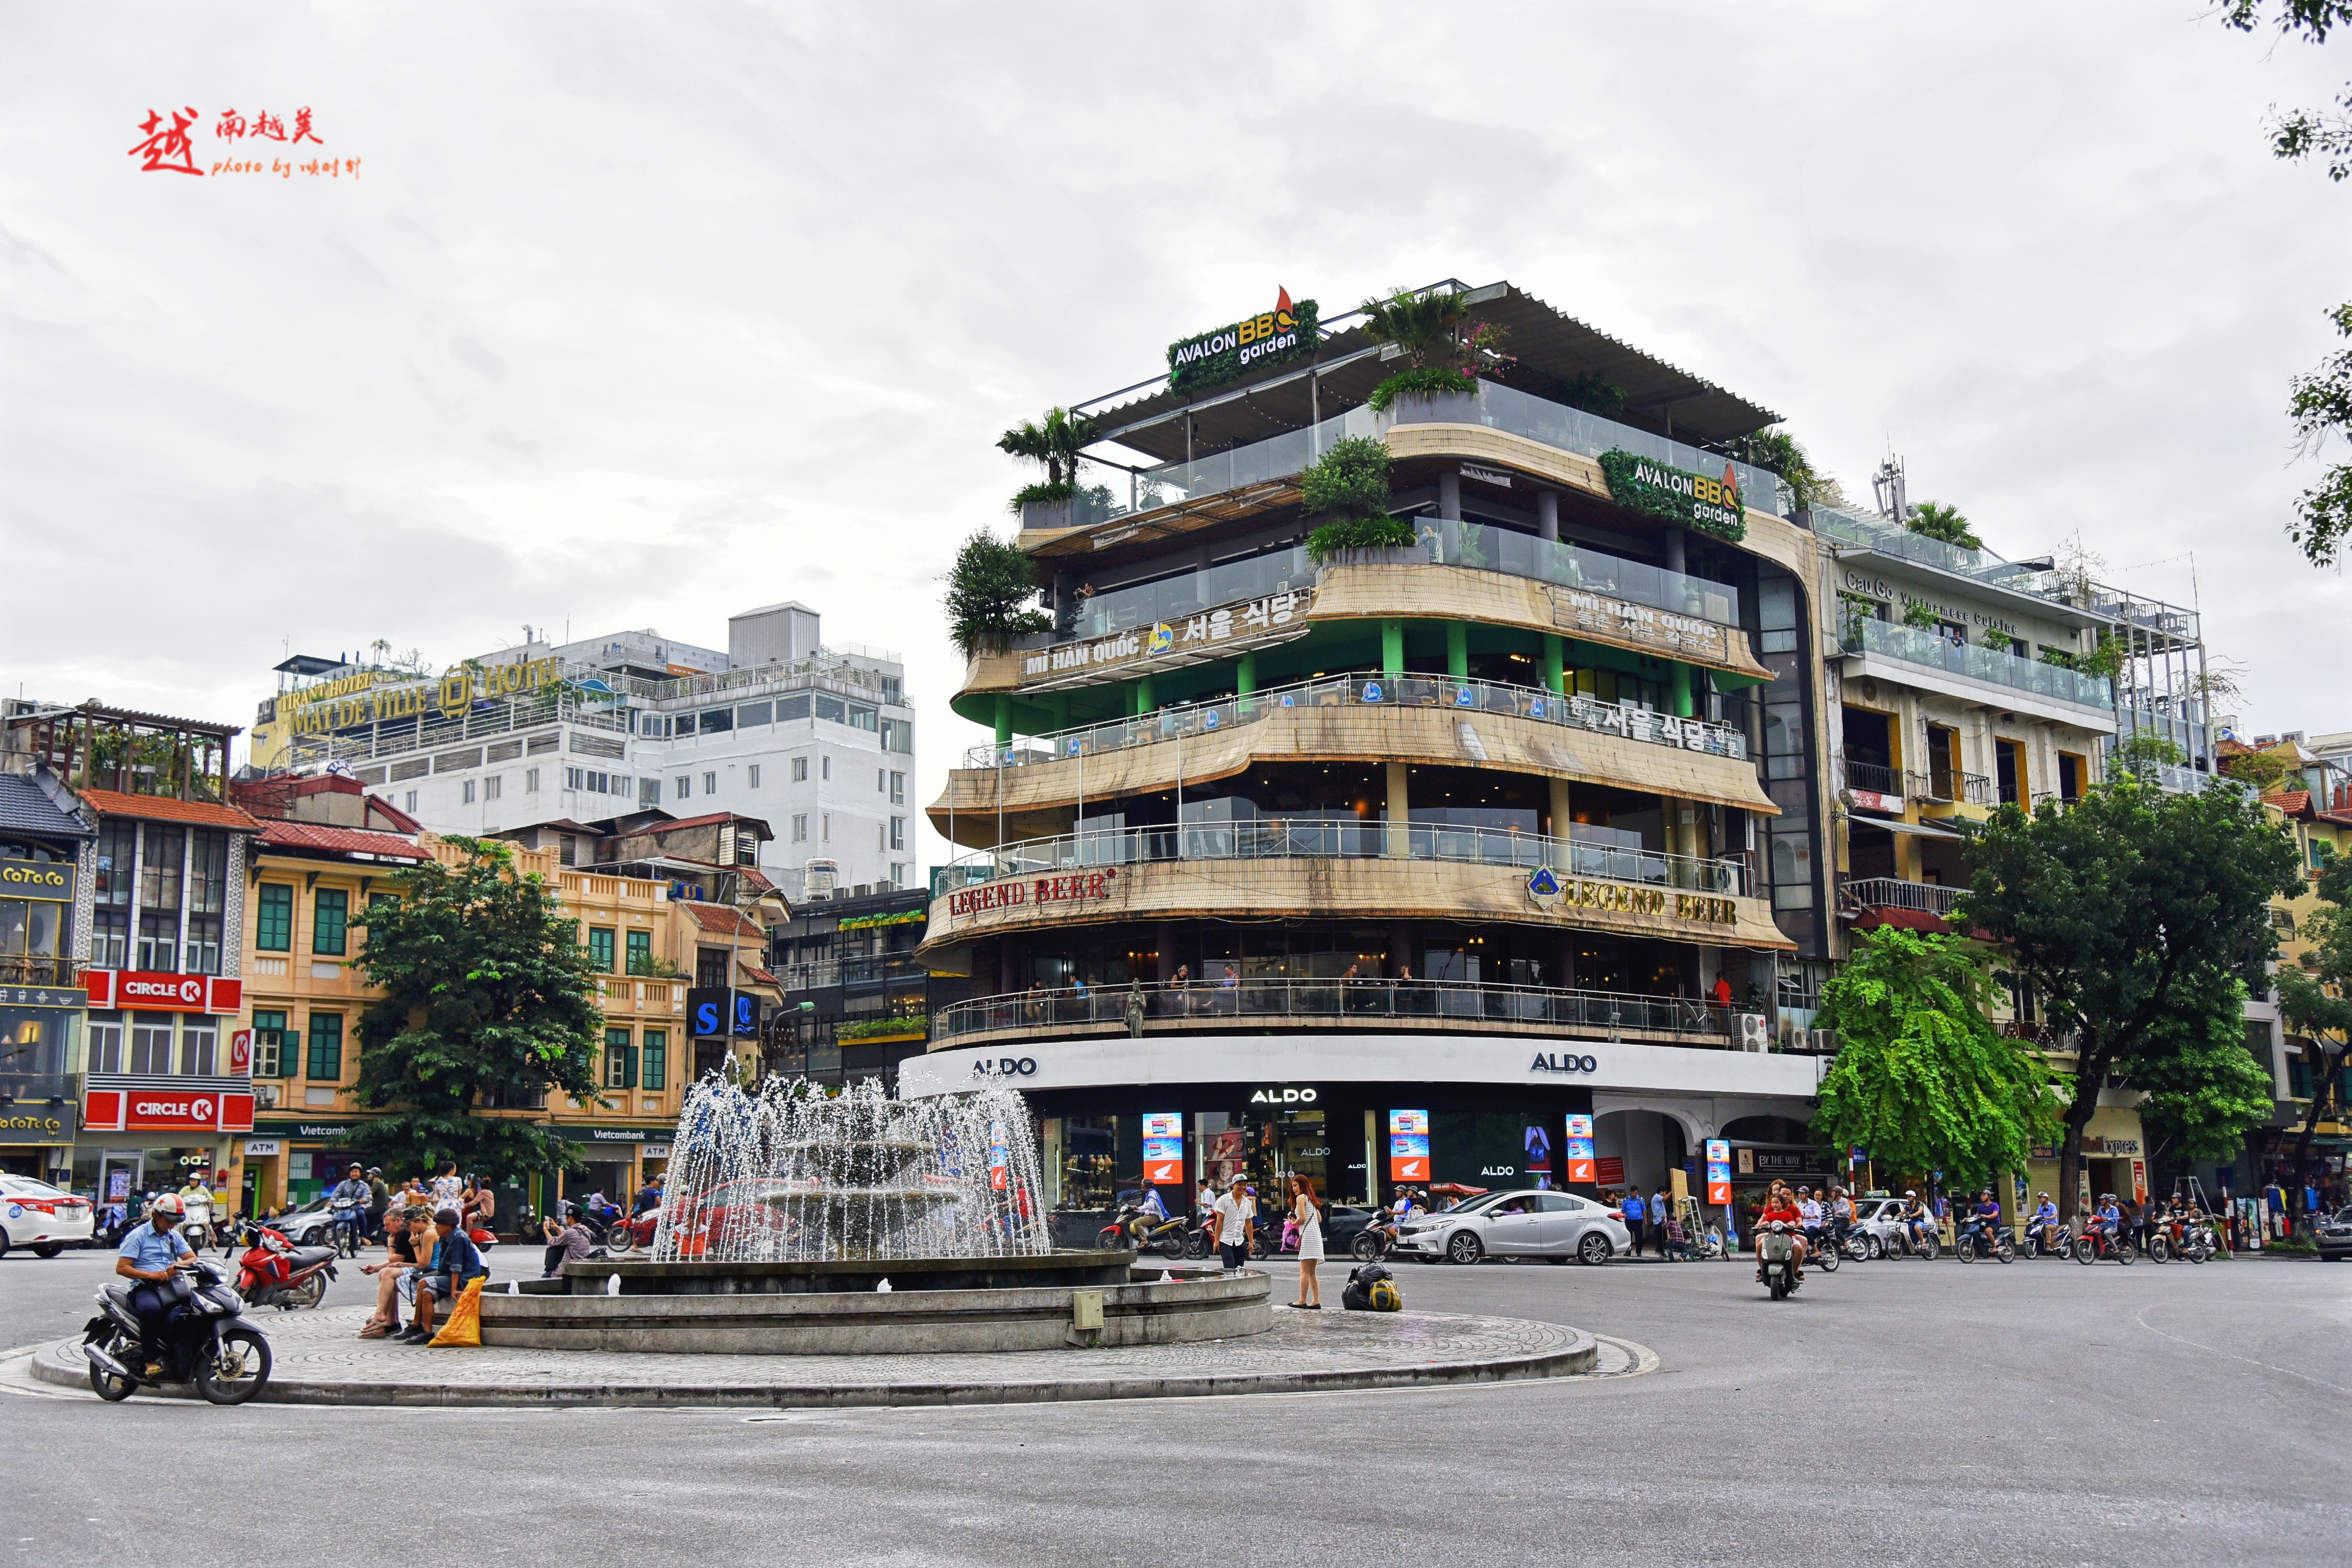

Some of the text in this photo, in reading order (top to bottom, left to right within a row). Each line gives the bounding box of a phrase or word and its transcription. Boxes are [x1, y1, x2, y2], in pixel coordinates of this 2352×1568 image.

[1175, 308, 1298, 366] AVALON BBQ
[1240, 333, 1296, 365] garden
[1635, 463, 1739, 512] AVALON BBQ
[1694, 503, 1737, 526] garden
[1571, 593, 1717, 639] MÌ HÀN QUỐC
[1846, 571, 1872, 594] Cau
[1875, 579, 1894, 600] Go
[1975, 612, 2018, 634] Cuisine
[1182, 593, 1299, 642] 서울 식당
[1027, 631, 1140, 675] MÌ HÀN QUỐC
[484, 656, 562, 698] HOTEL
[280, 684, 326, 712] TIRANT
[330, 672, 373, 697] HOTEL
[291, 685, 427, 735] MAY DE VILLE
[1602, 707, 1652, 741] 서울
[1660, 715, 1706, 751] 식당
[948, 882, 1025, 916] LEGEND
[1565, 879, 1738, 925] LEGEND BEER
[126, 982, 177, 997] CIRCLE
[973, 1057, 1038, 1078] ALDO
[1529, 1052, 1597, 1073] ALDO
[1251, 1088, 1317, 1102] ALDO
[136, 1102, 188, 1116] CIRCLE
[300, 1125, 349, 1135] Vietcomb
[594, 1130, 645, 1140] Vietcombank
[251, 1144, 274, 1152] ATM
[1301, 1147, 1330, 1157] ALDO
[2103, 1137, 2138, 1153] Express
[1481, 1166, 1514, 1176] ALDO
[1759, 1155, 1769, 1165] BY
[1771, 1155, 1784, 1165] THE
[1785, 1156, 1800, 1165] WAY
